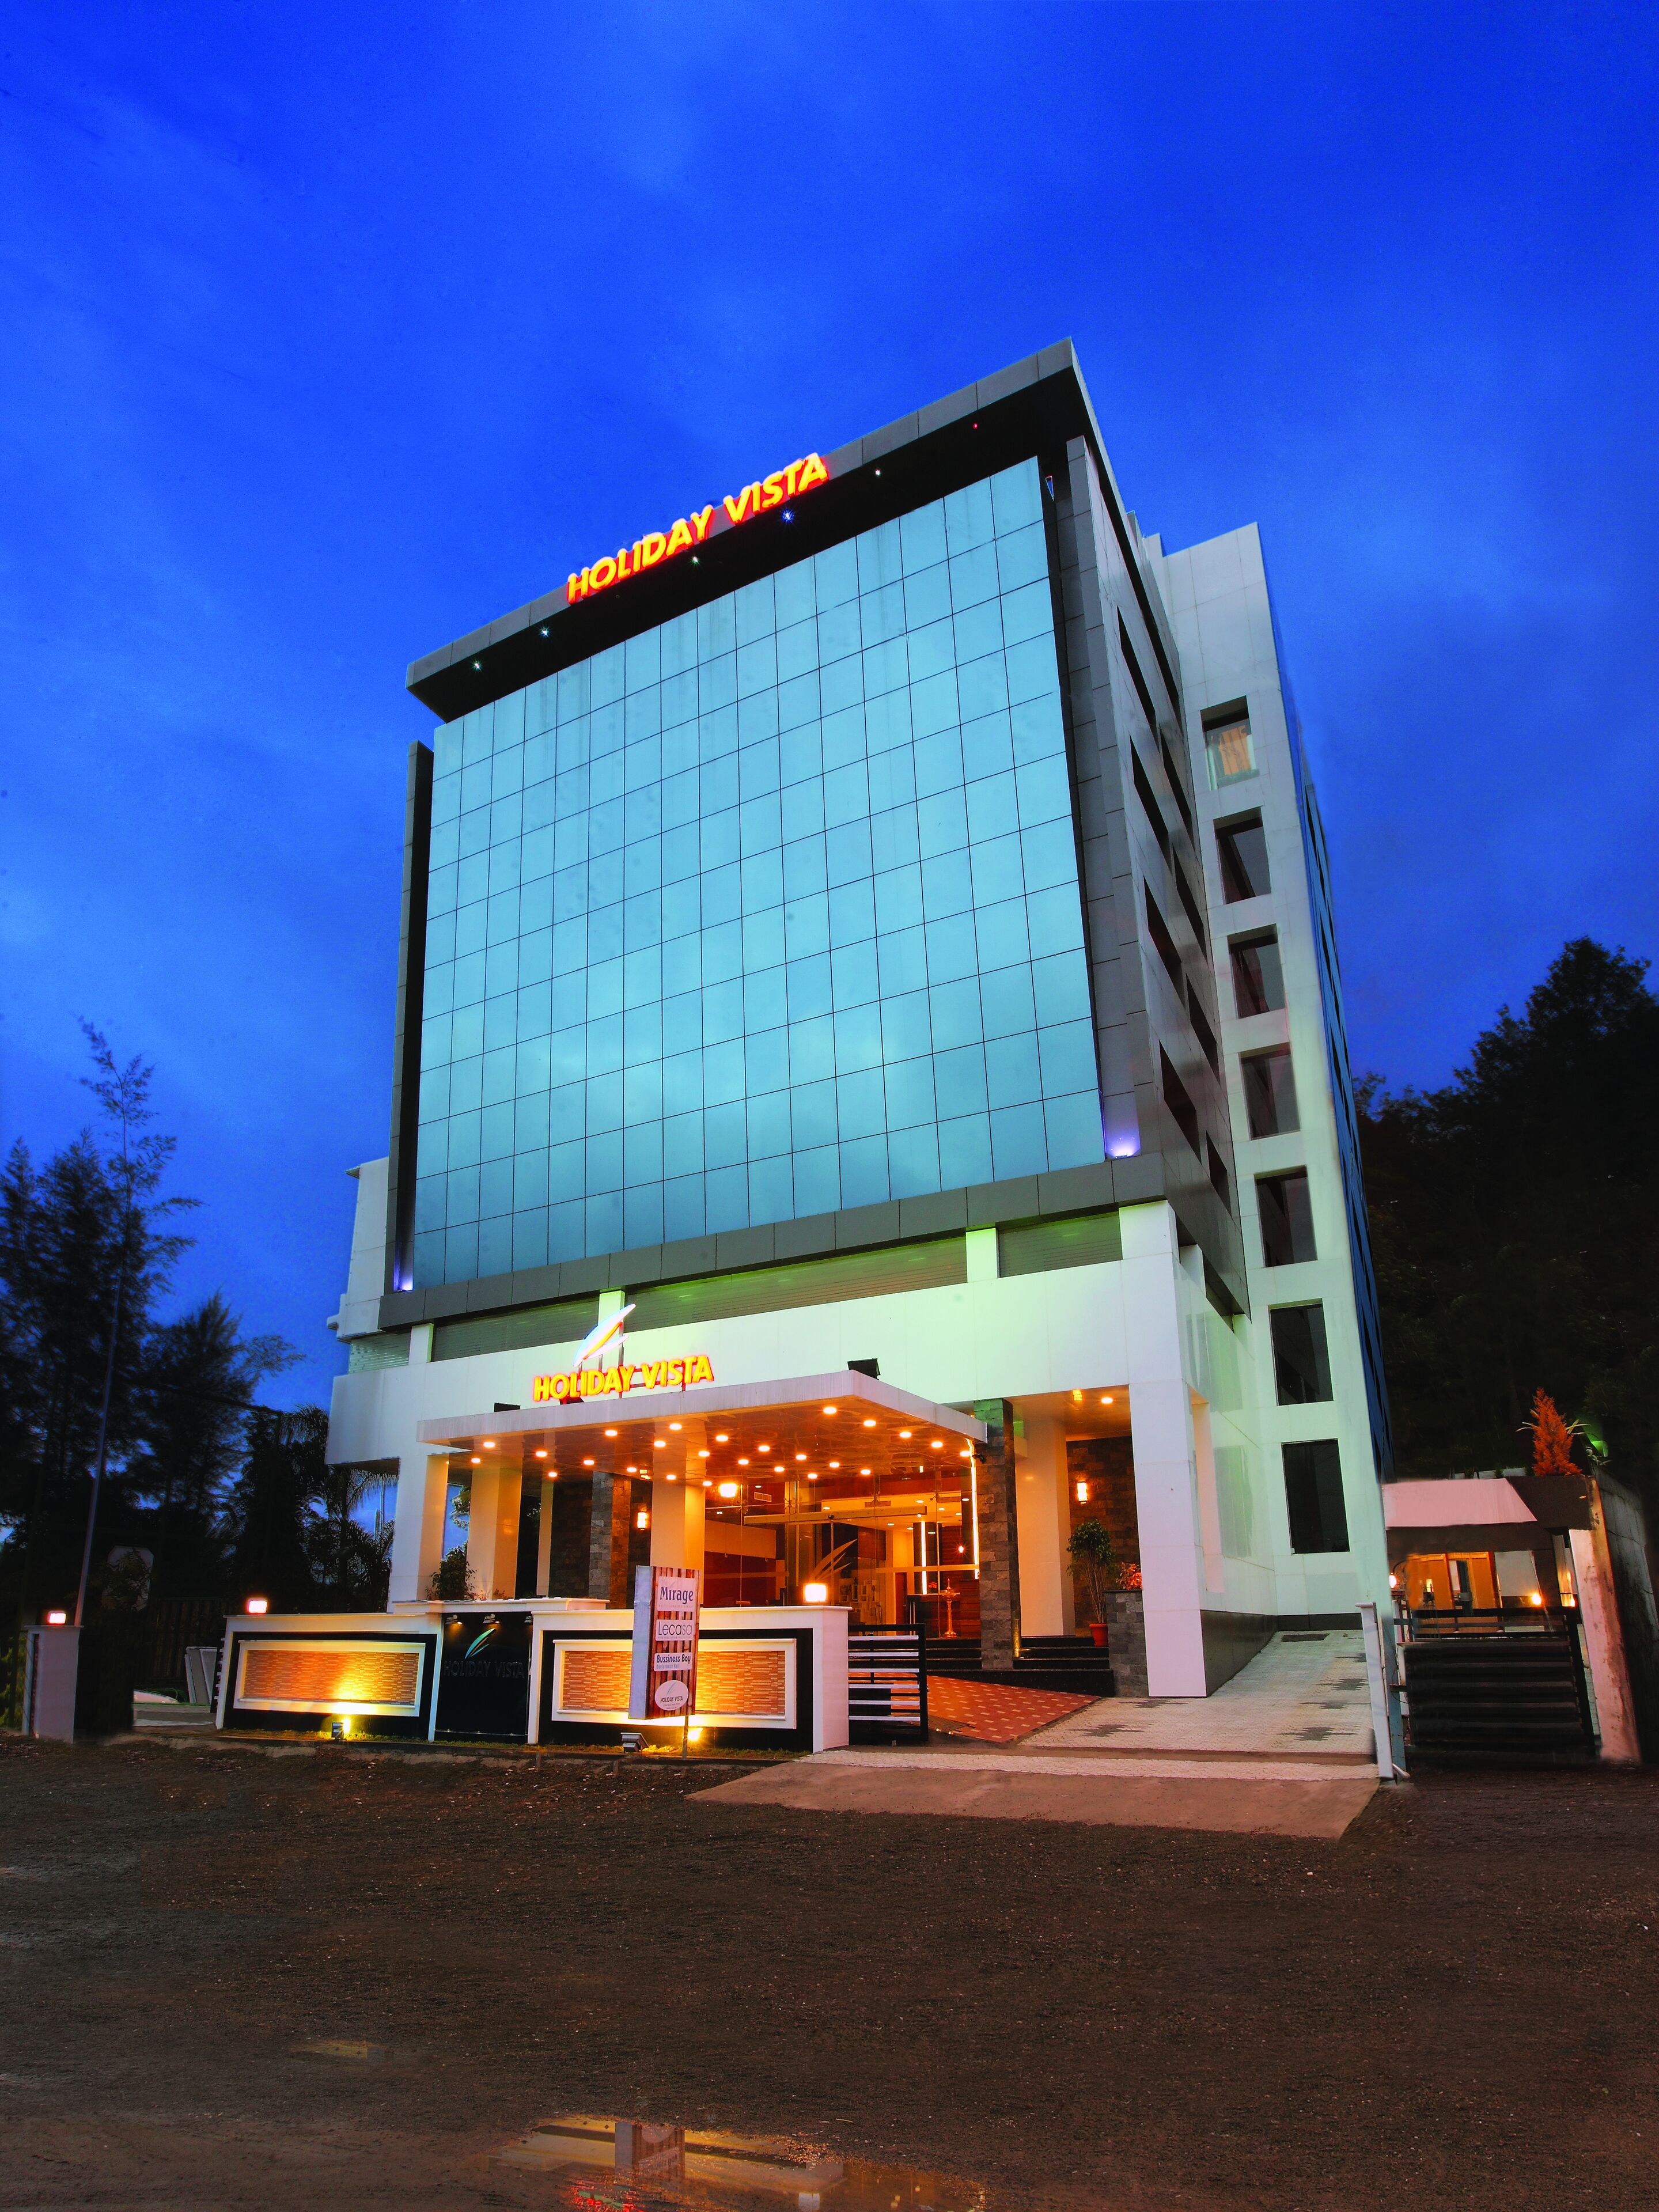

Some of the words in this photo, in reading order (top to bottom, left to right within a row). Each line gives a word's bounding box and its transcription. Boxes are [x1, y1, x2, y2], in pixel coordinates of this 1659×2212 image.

[566, 504, 714, 605] HOLIDAY
[723, 452, 830, 525] VISTA
[533, 1364, 636, 1402] HOLIDAY
[641, 1355, 714, 1389] VISTA
[660, 1586, 694, 1605] Mirage
[658, 1621, 692, 1635] Lecasa
[656, 1654, 680, 1663] Bussiness
[681, 1653, 691, 1664] Bay
[443, 1660, 491, 1677] HOLIDAY
[494, 1661, 525, 1679] VISTA
